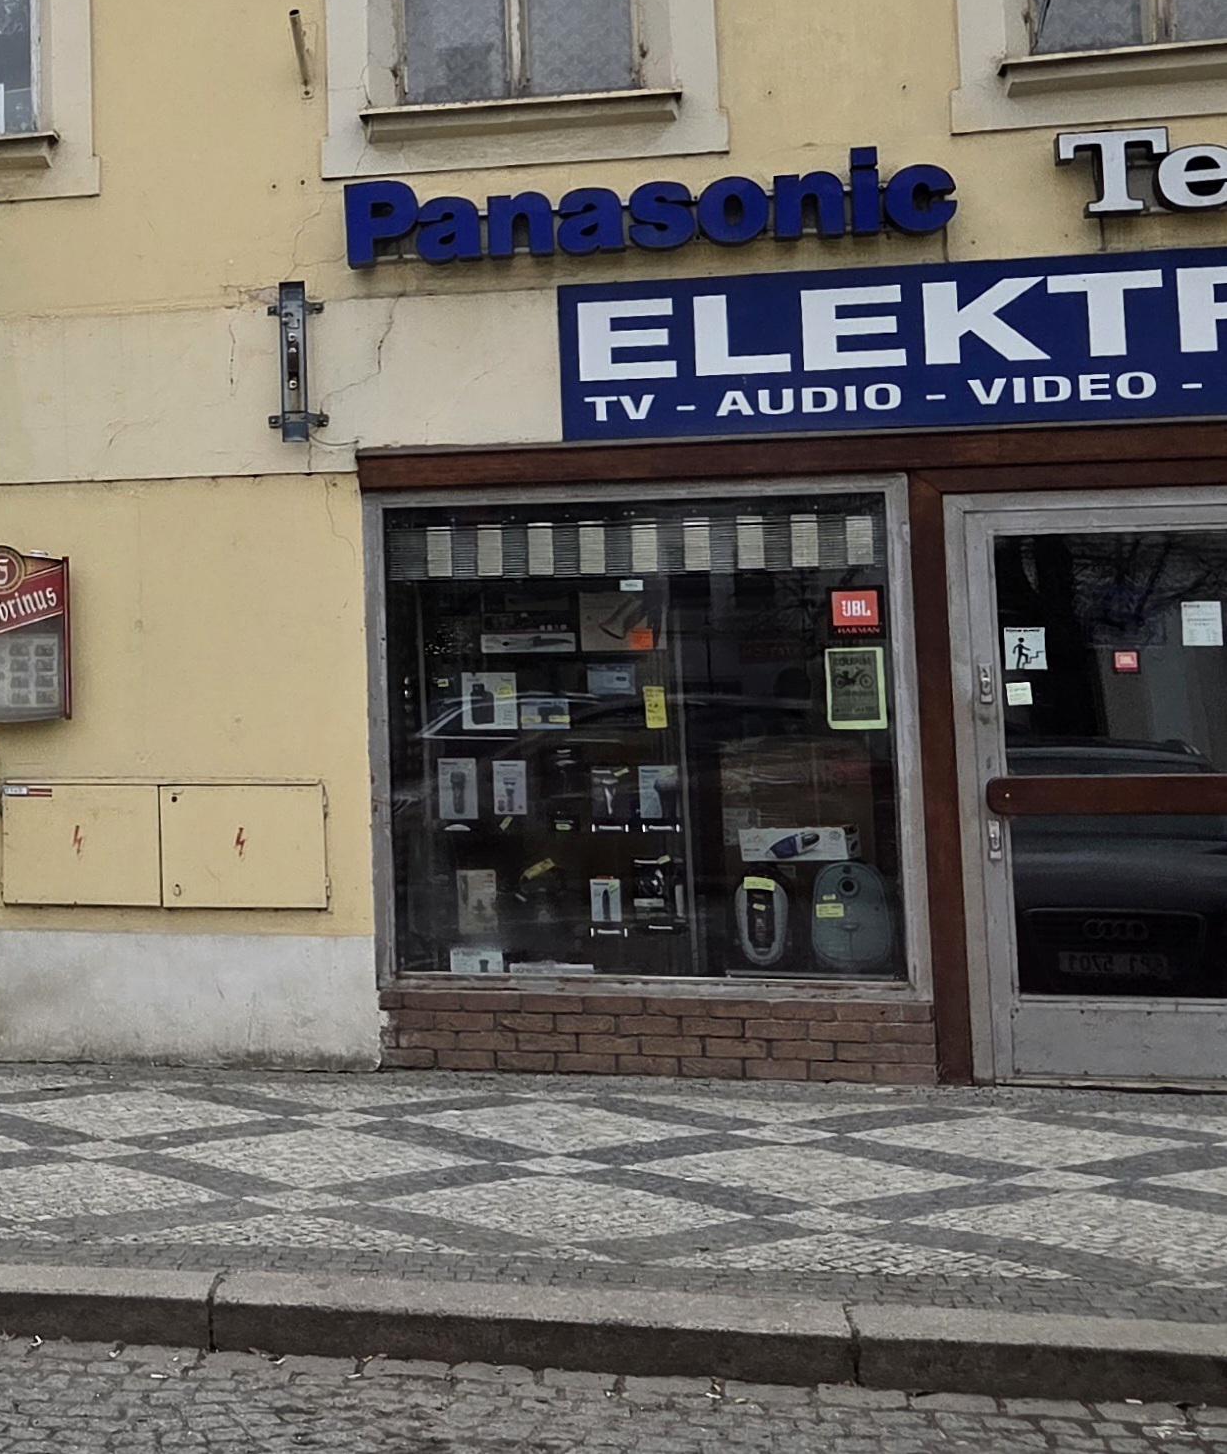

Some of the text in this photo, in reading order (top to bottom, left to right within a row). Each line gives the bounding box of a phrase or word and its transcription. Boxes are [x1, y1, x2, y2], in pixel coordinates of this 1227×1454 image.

[344, 146, 958, 270] Panasonic
[584, 394, 656, 422] TV
[716, 383, 901, 416] AUDIO
[967, 372, 1156, 405] VIDEO
[841, 600, 872, 617] JBL
